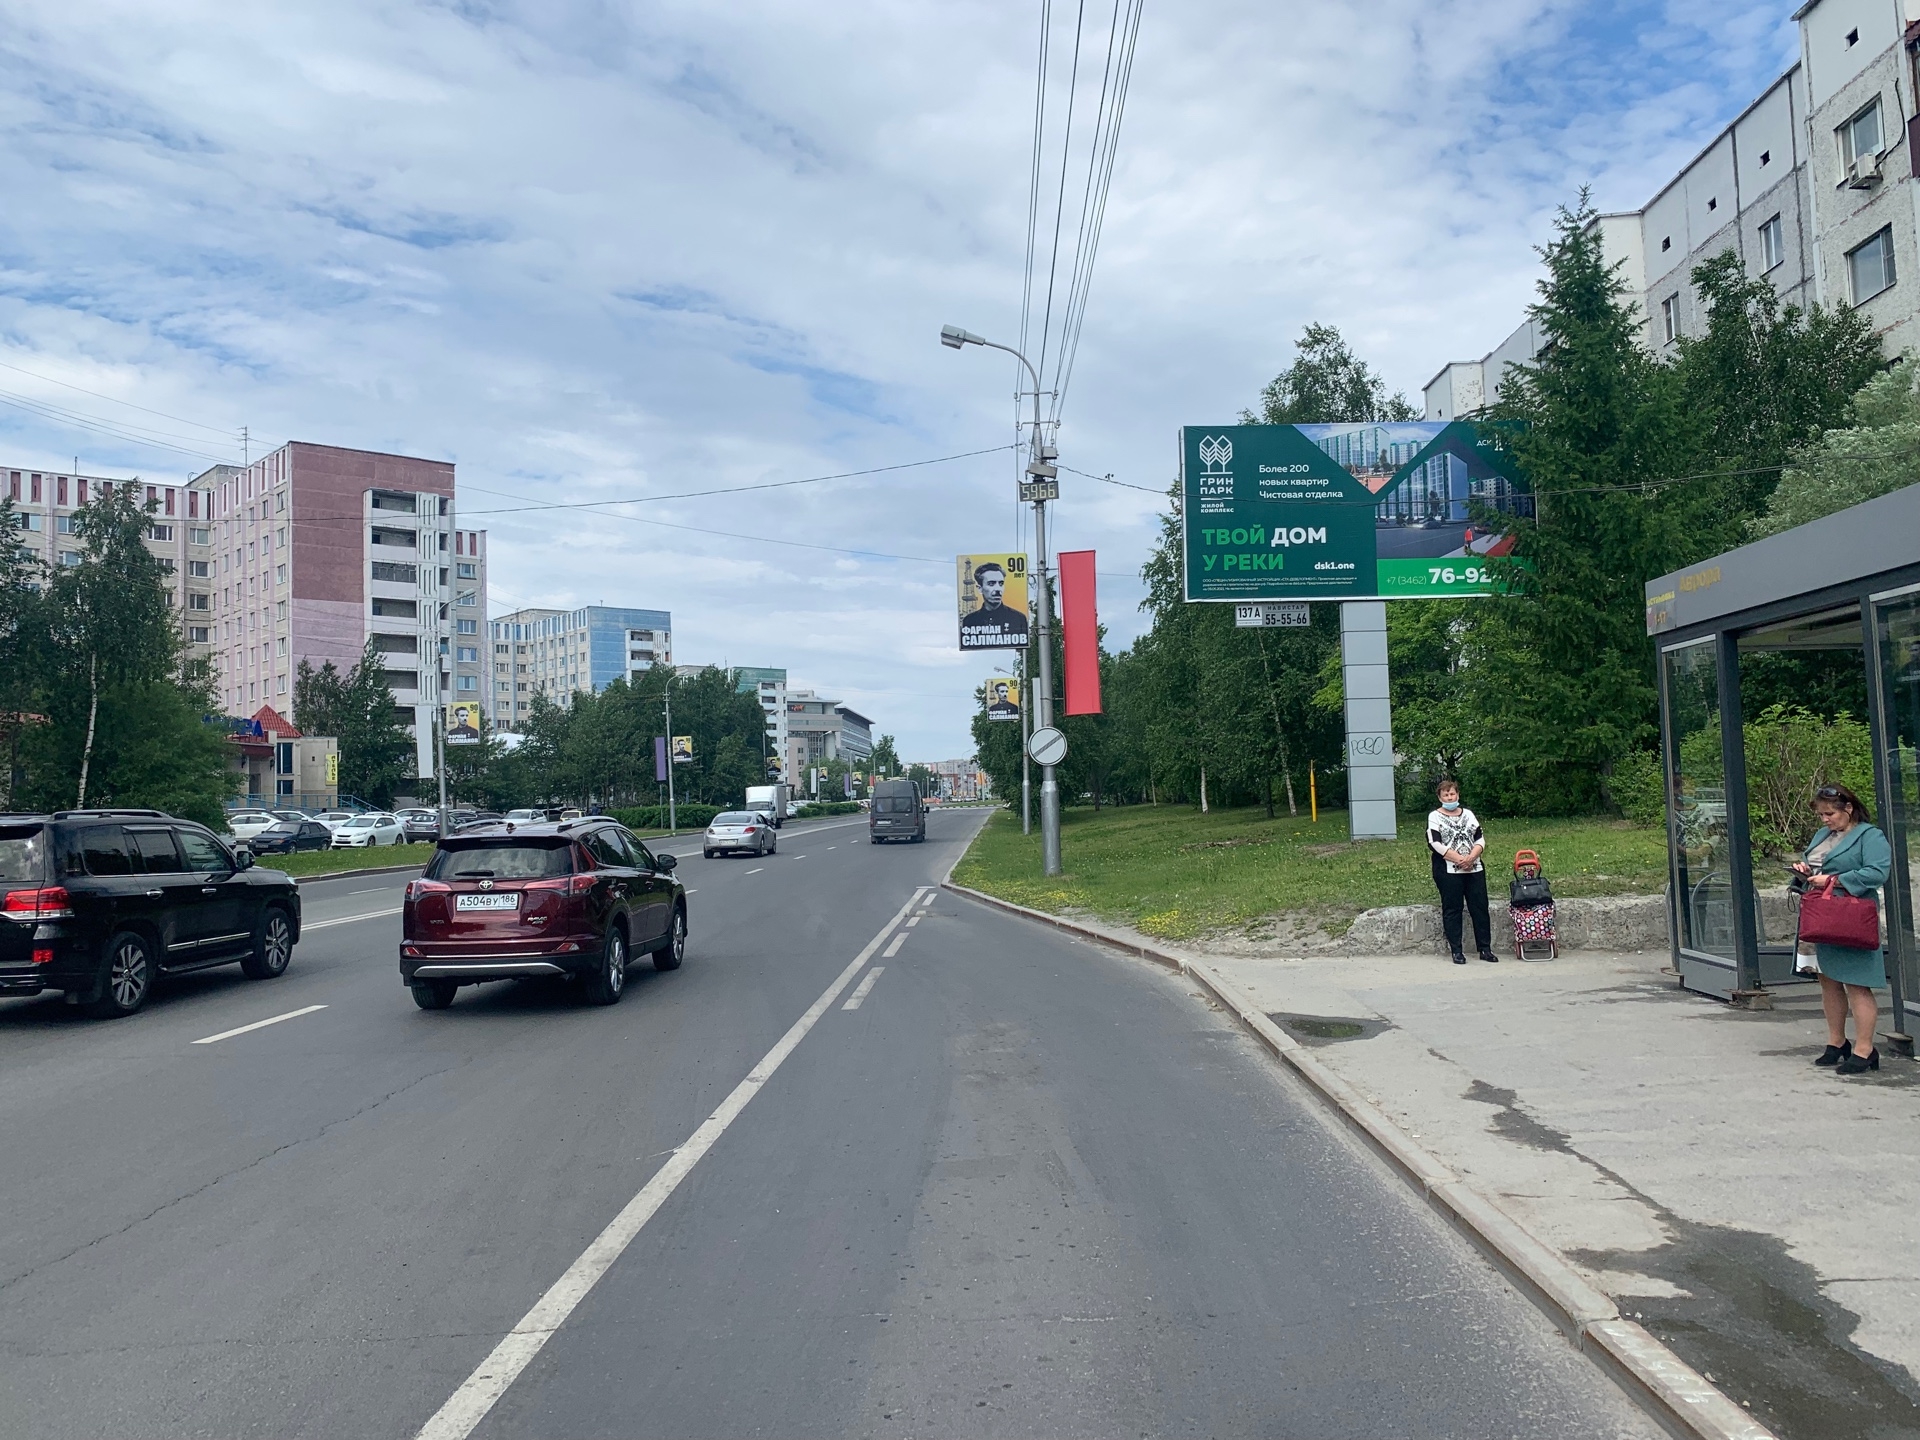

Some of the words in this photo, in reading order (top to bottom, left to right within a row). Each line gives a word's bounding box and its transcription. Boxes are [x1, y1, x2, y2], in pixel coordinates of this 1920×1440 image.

[1259, 464, 1288, 473] Более
[1289, 464, 1310, 473] 200
[1200, 477, 1234, 486] ГРИН
[1290, 478, 1329, 487] квартир
[1021, 483, 1056, 500] 5966
[1200, 486, 1233, 495] ПАРК
[1259, 491, 1303, 499] Чистовая
[1305, 490, 1343, 499] отделка
[1202, 524, 1265, 546] ТВОЙ
[1271, 526, 1327, 548] ДОМ
[1007, 557, 1025, 573] 90
[1202, 554, 1217, 571] У
[1223, 553, 1284, 571] РЕКИ
[1314, 561, 1355, 570] dsk1.one
[1386, 576, 1396, 584] +7
[1398, 575, 1427, 586] (3462)
[1265, 613, 1307, 625] 55-55-66
[962, 625, 1001, 635] ФАРМАН
[962, 634, 1028, 646] САЛМАНОВ
[460, 896, 499, 907] А504ВУ
[501, 894, 516, 903] 186
